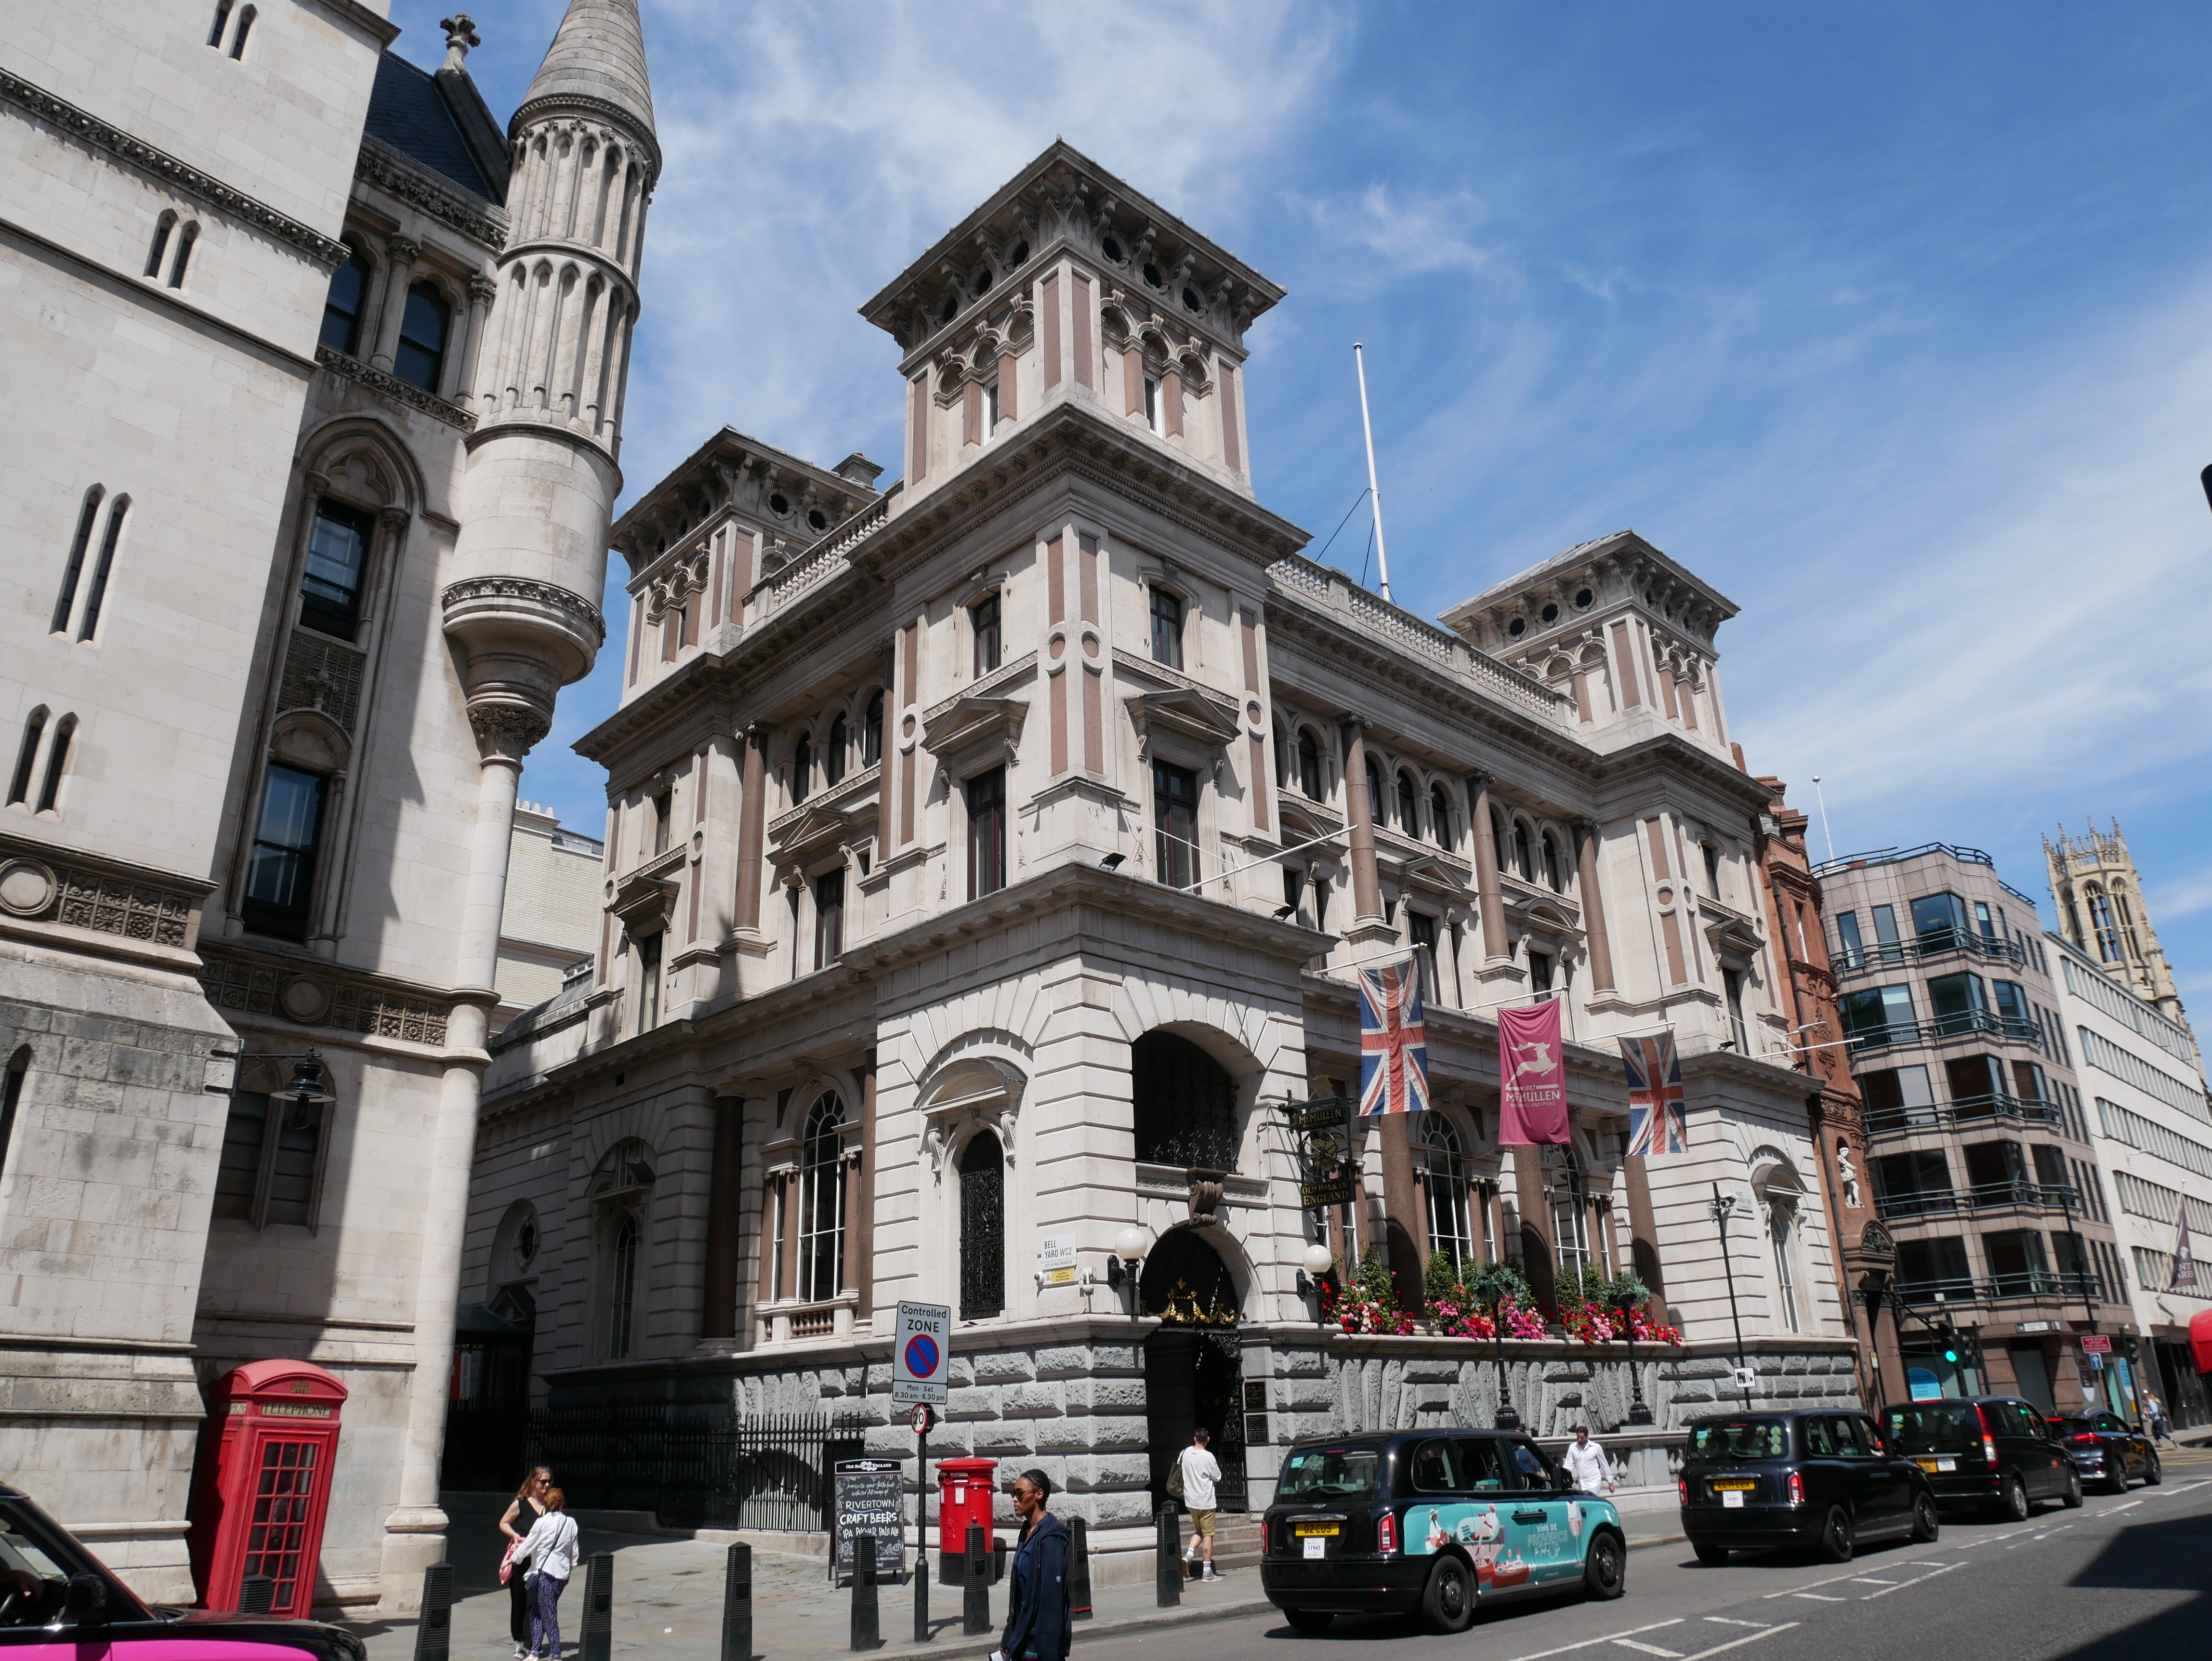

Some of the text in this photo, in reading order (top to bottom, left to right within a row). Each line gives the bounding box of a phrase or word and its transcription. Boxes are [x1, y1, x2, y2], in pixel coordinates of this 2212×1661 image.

[1302, 1186, 1316, 1195] OLD
[1318, 1184, 1337, 1193] BANK
[1303, 1190, 1348, 1206] ENGLAND
[1044, 1240, 1057, 1249] BELL
[1044, 1247, 1072, 1259] YARD WC2
[902, 1305, 947, 1318] Controlled
[908, 1319, 939, 1332] ZONE
[264, 1402, 331, 1417] TELEPHONE
[912, 1412, 923, 1425] 20
[1718, 1481, 1734, 1489] LL71
[846, 1499, 895, 1509] RIVERTOWN
[840, 1511, 897, 1525] CRAFT BEERS
[843, 1529, 853, 1539] IPA
[879, 1526, 891, 1536] PALE
[891, 1527, 899, 1536] ALE
[1304, 1524, 1331, 1533] G2 CUS
[1527, 1530, 1568, 1547] PROVENCE
